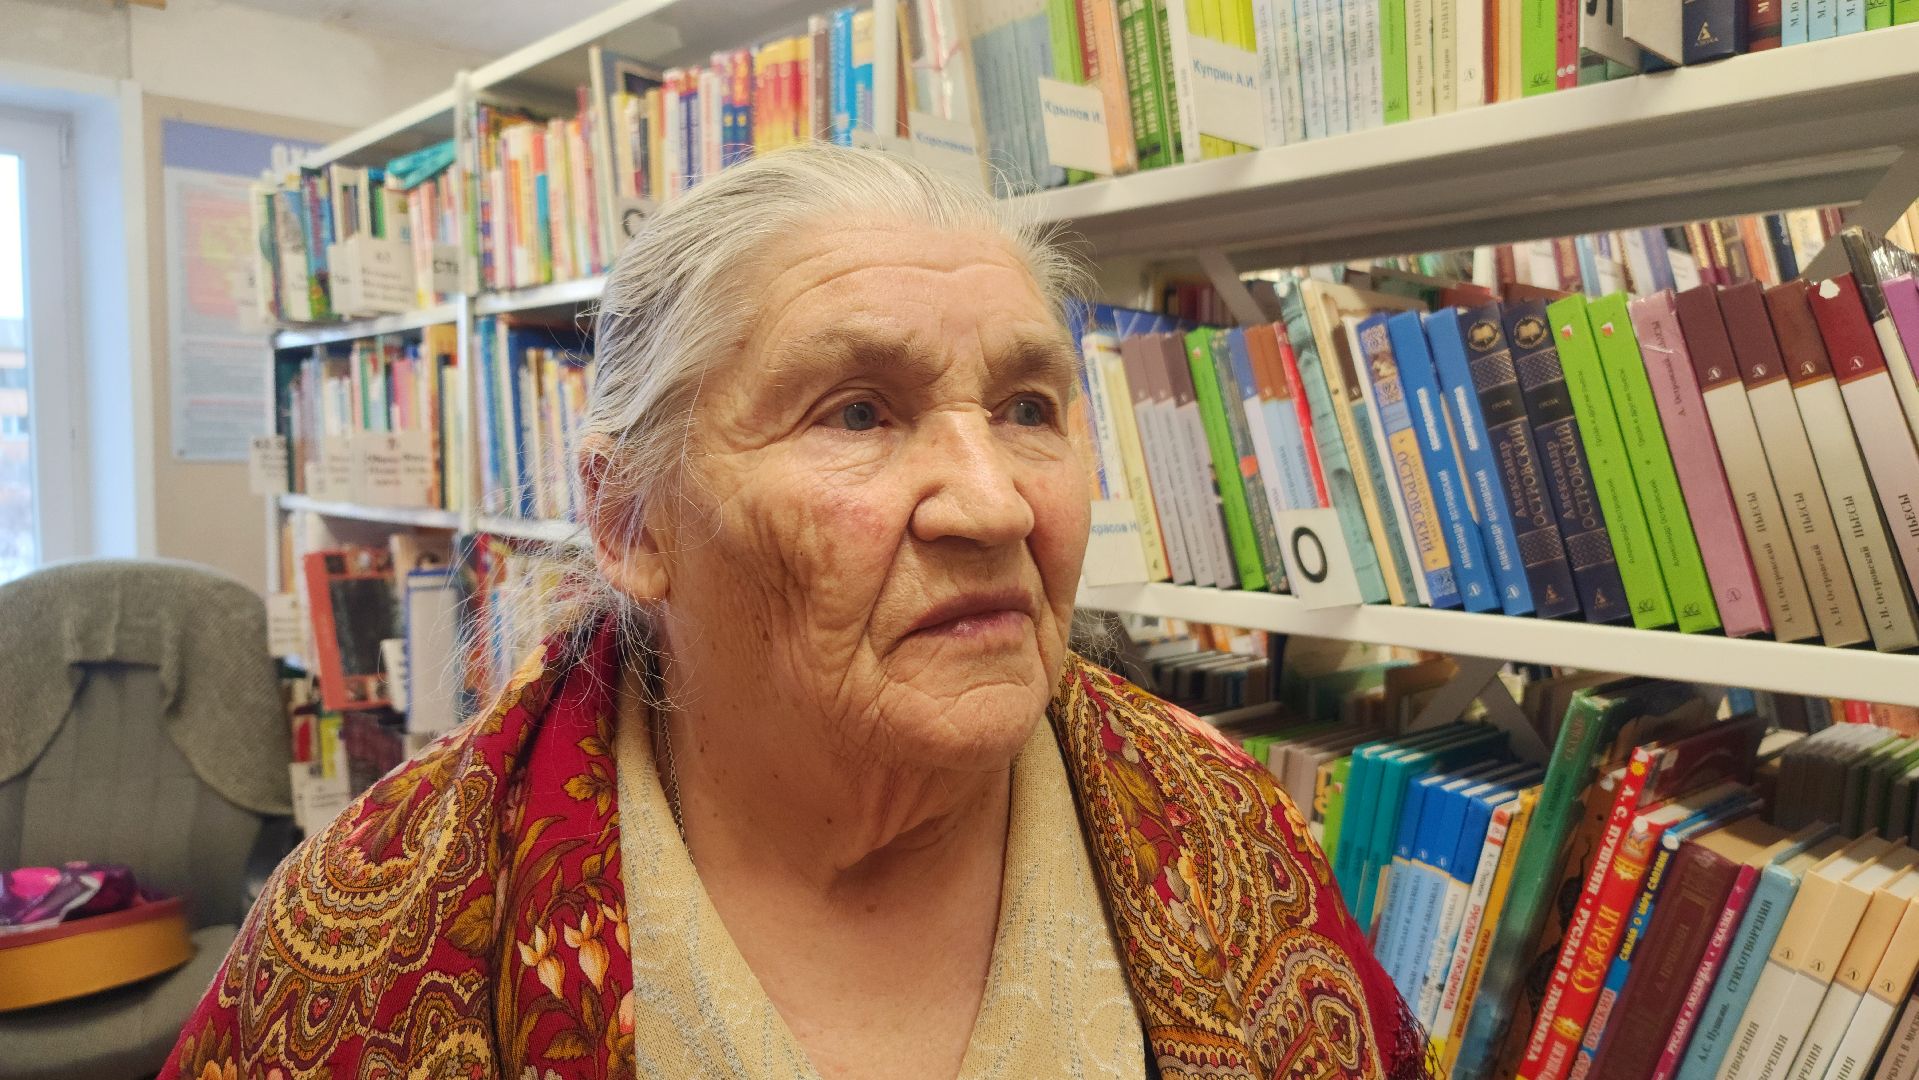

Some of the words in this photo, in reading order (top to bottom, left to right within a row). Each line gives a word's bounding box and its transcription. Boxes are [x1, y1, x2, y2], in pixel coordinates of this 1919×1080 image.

[1192, 58, 1232, 82] Куприн
[1438, 470, 1459, 520] ОСТРОВСКИЙ
[1476, 469, 1497, 521] ОСТРОВСКИЙ
[1499, 440, 1526, 517] Александр
[1510, 424, 1546, 524] ОСТРОВСКИЙ
[1547, 441, 1574, 518] Александр
[1557, 423, 1595, 524] ОСТРОВСКИЙ
[1392, 450, 1436, 551] ОСТРОВСКИЙ
[1747, 492, 1766, 533] ПЬЕСЫ
[1794, 492, 1814, 533] ПЬЕСЫ
[1843, 495, 1864, 538] ПЬЕСЫ
[1898, 493, 1919, 537] ПЬЕСЫ
[1292, 526, 1328, 584] О
[1453, 523, 1472, 568] АЛЕКСАНДР
[1491, 523, 1511, 570] АЛЕКСАНДР
[1764, 543, 1786, 599] Островский
[1813, 544, 1835, 601] Островский
[1862, 546, 1885, 604] Островский
[1784, 613, 1793, 623] А.
[1834, 616, 1842, 626] А.
[1879, 606, 1889, 618] Н.
[1883, 620, 1893, 631] А.
[1613, 804, 1627, 821] С.
[1620, 785, 1634, 802] А.
[1588, 825, 1620, 893] ПУШКИН
[1464, 905, 1480, 943] РУСЛАН
[1561, 908, 1590, 968] РУСЛАН
[1574, 906, 1617, 993] СКАЗКИ
[1727, 900, 1771, 992] СТИХОТВОРЕНИЯ
[1444, 957, 1465, 1009] ЛЮДМИЛА
[1555, 970, 1567, 983] И
[1667, 1018, 1687, 1054] РУСЛАН
[1687, 961, 1712, 1008] ЛЮДМИЛА
[1712, 908, 1734, 947] СКАЗКИ
[1528, 985, 1561, 1060] ЛЮДМИЛА
